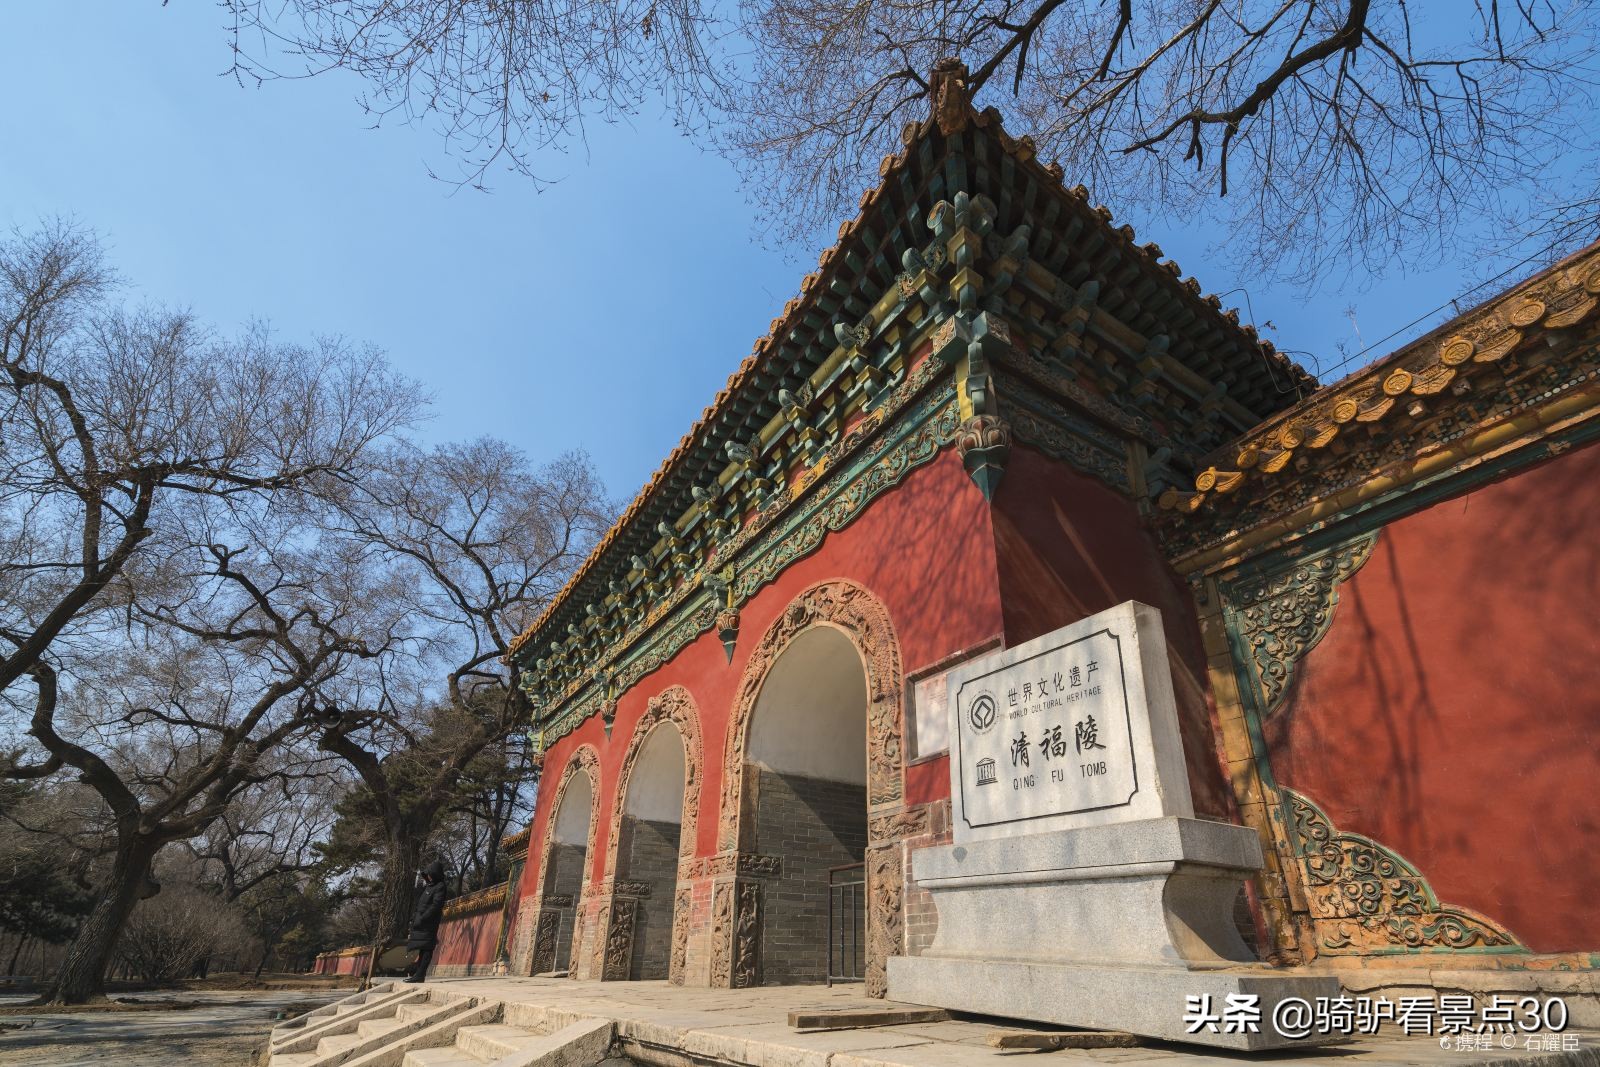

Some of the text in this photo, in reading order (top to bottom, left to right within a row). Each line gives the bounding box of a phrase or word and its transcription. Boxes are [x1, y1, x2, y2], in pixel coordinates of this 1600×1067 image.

[1008, 661, 1098, 707] 世界文化遗产
[1009, 685, 1101, 720] WORLD CULTURAL HERITAGE
[1010, 714, 1107, 768] 清福陵
[1013, 761, 1107, 791] QING FU TOMB
